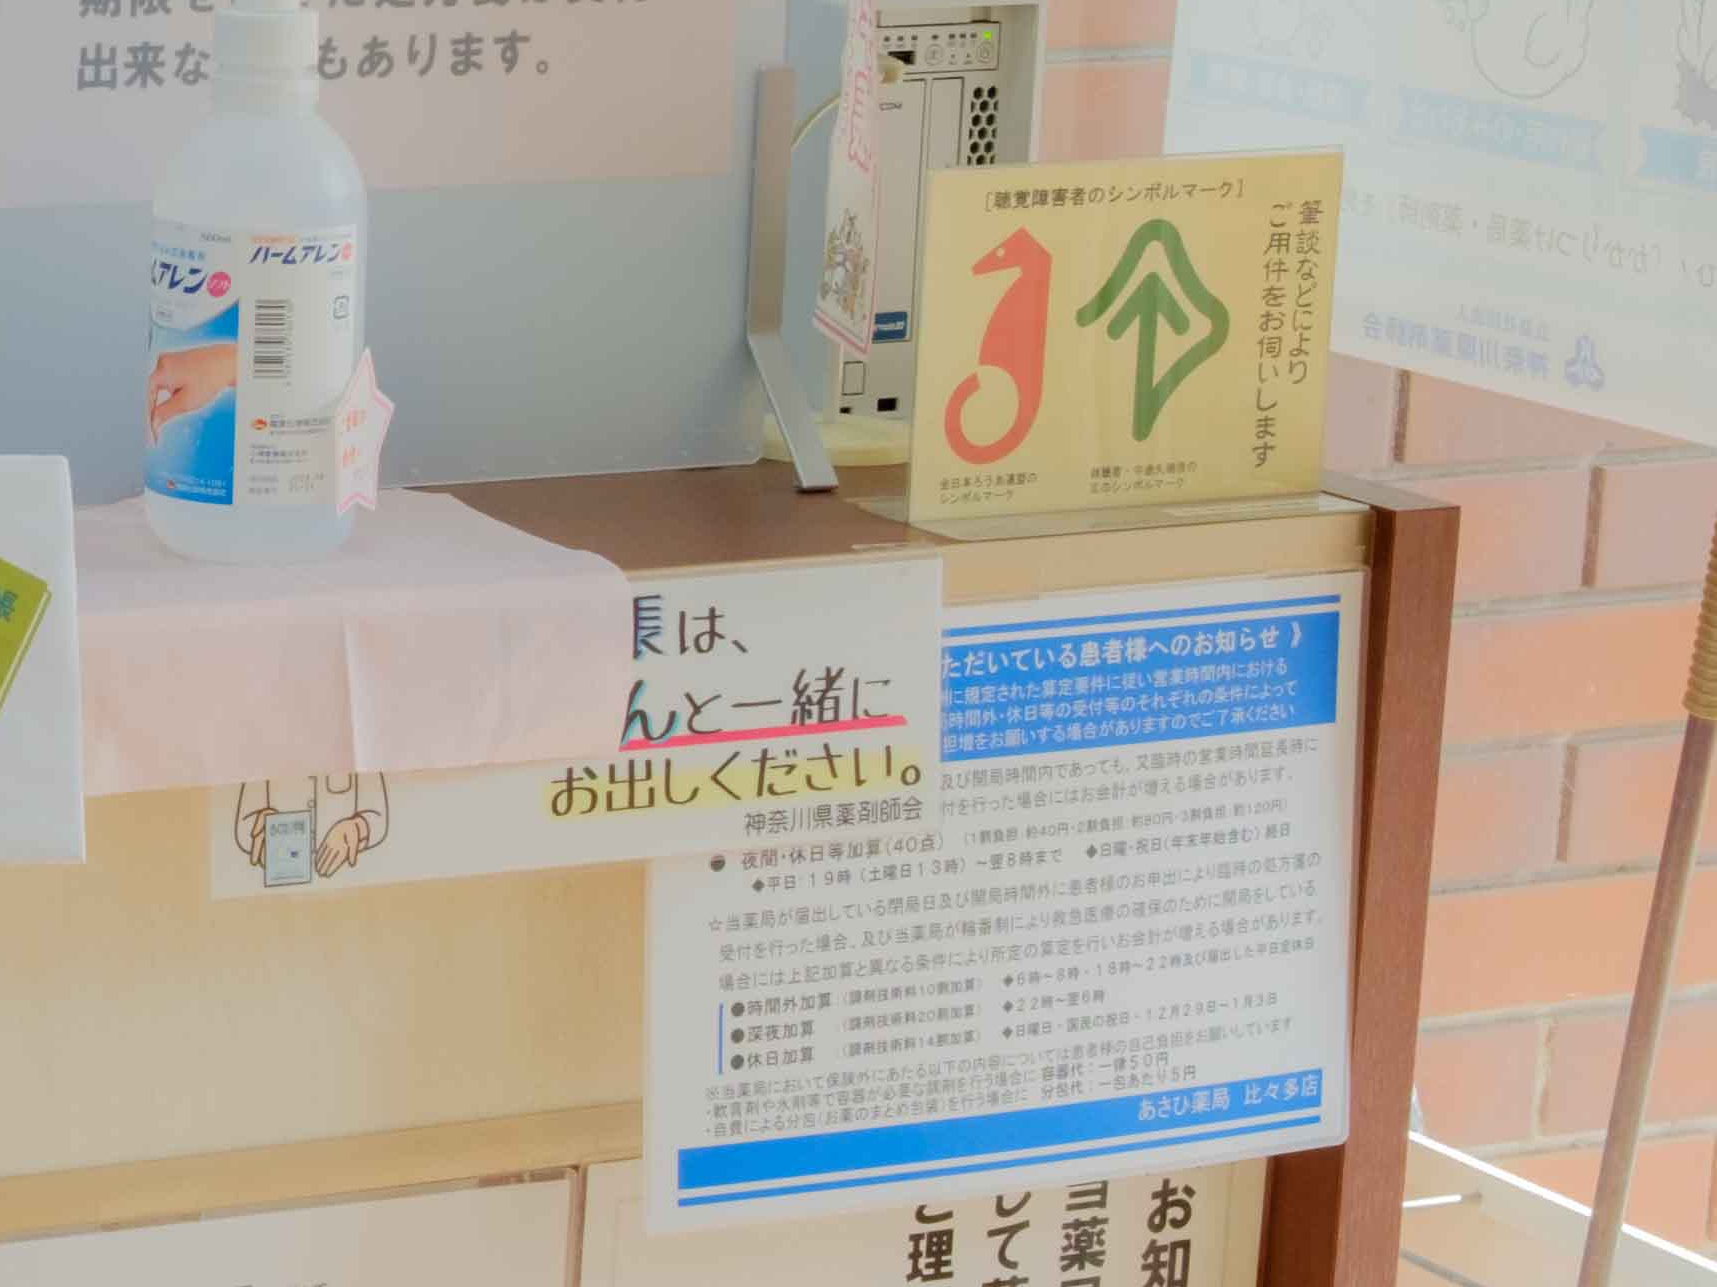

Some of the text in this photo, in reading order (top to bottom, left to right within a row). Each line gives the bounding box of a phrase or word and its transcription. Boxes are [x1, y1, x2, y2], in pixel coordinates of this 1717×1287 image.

[76, 28, 552, 91] 出来なもあります。
[151, 261, 207, 294] アレン
[1288, 200, 1322, 385] 筆談などにより
[1251, 201, 1293, 469] ご用件をお伺いします
[549, 744, 922, 817] お出しください。
[744, 797, 924, 836] 神奈川県薬剤師会
[1138, 1075, 1319, 1121] あさひ薬局 比々多店
